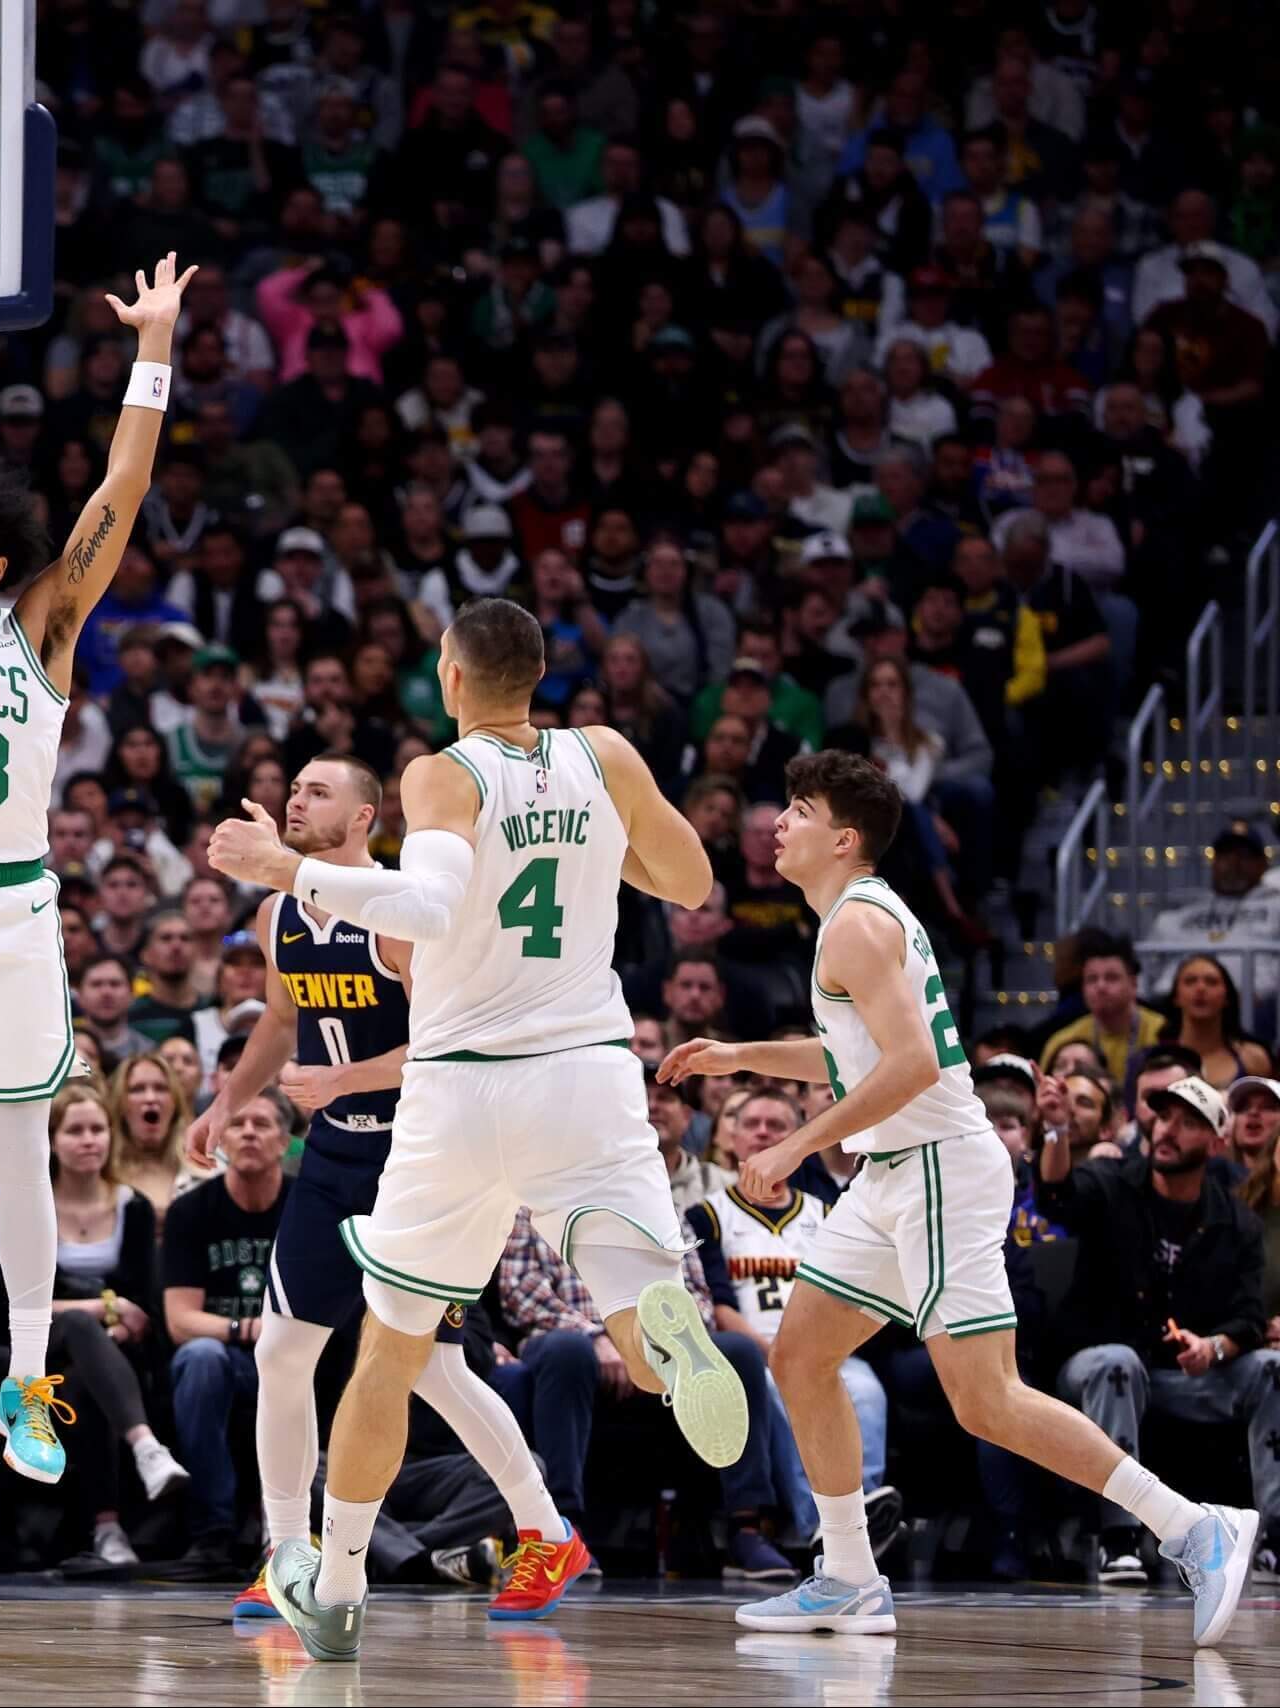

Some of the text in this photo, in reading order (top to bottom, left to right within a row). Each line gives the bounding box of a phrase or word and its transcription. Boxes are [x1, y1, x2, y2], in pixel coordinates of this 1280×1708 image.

[500, 800, 592, 852] VUČEVIĆ
[497, 857, 564, 959] 4
[335, 931, 365, 944] ibotta
[280, 972, 380, 1009] DENVER
[318, 1016, 352, 1066] 0
[207, 1237, 271, 1272] BOST
